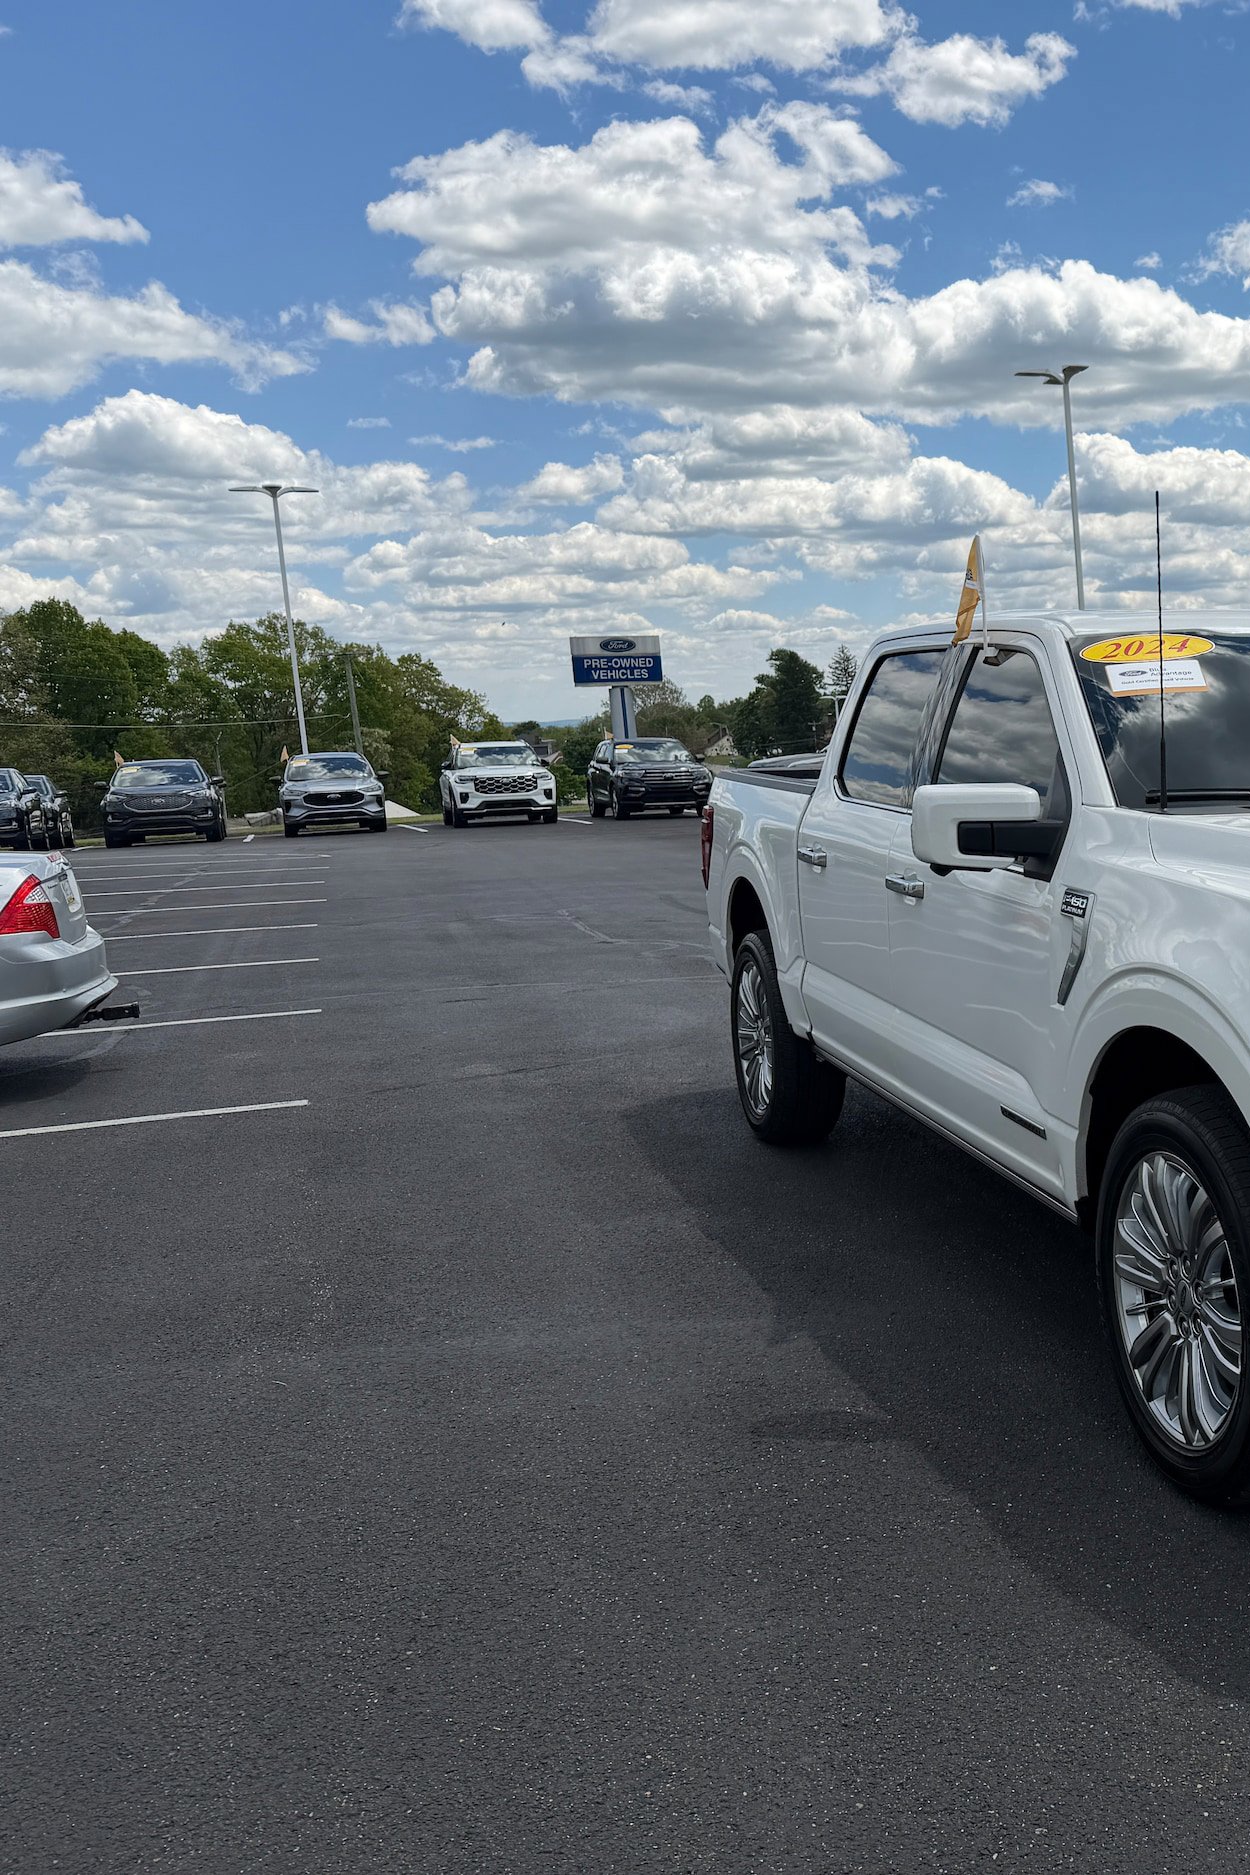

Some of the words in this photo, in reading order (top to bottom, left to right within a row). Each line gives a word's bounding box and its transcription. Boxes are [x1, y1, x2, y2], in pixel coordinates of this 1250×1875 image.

[607, 640, 629, 649] Ford
[1100, 637, 1191, 660] 2024
[583, 657, 654, 669] PRE-OWNED
[591, 669, 649, 680] VEHICLES
